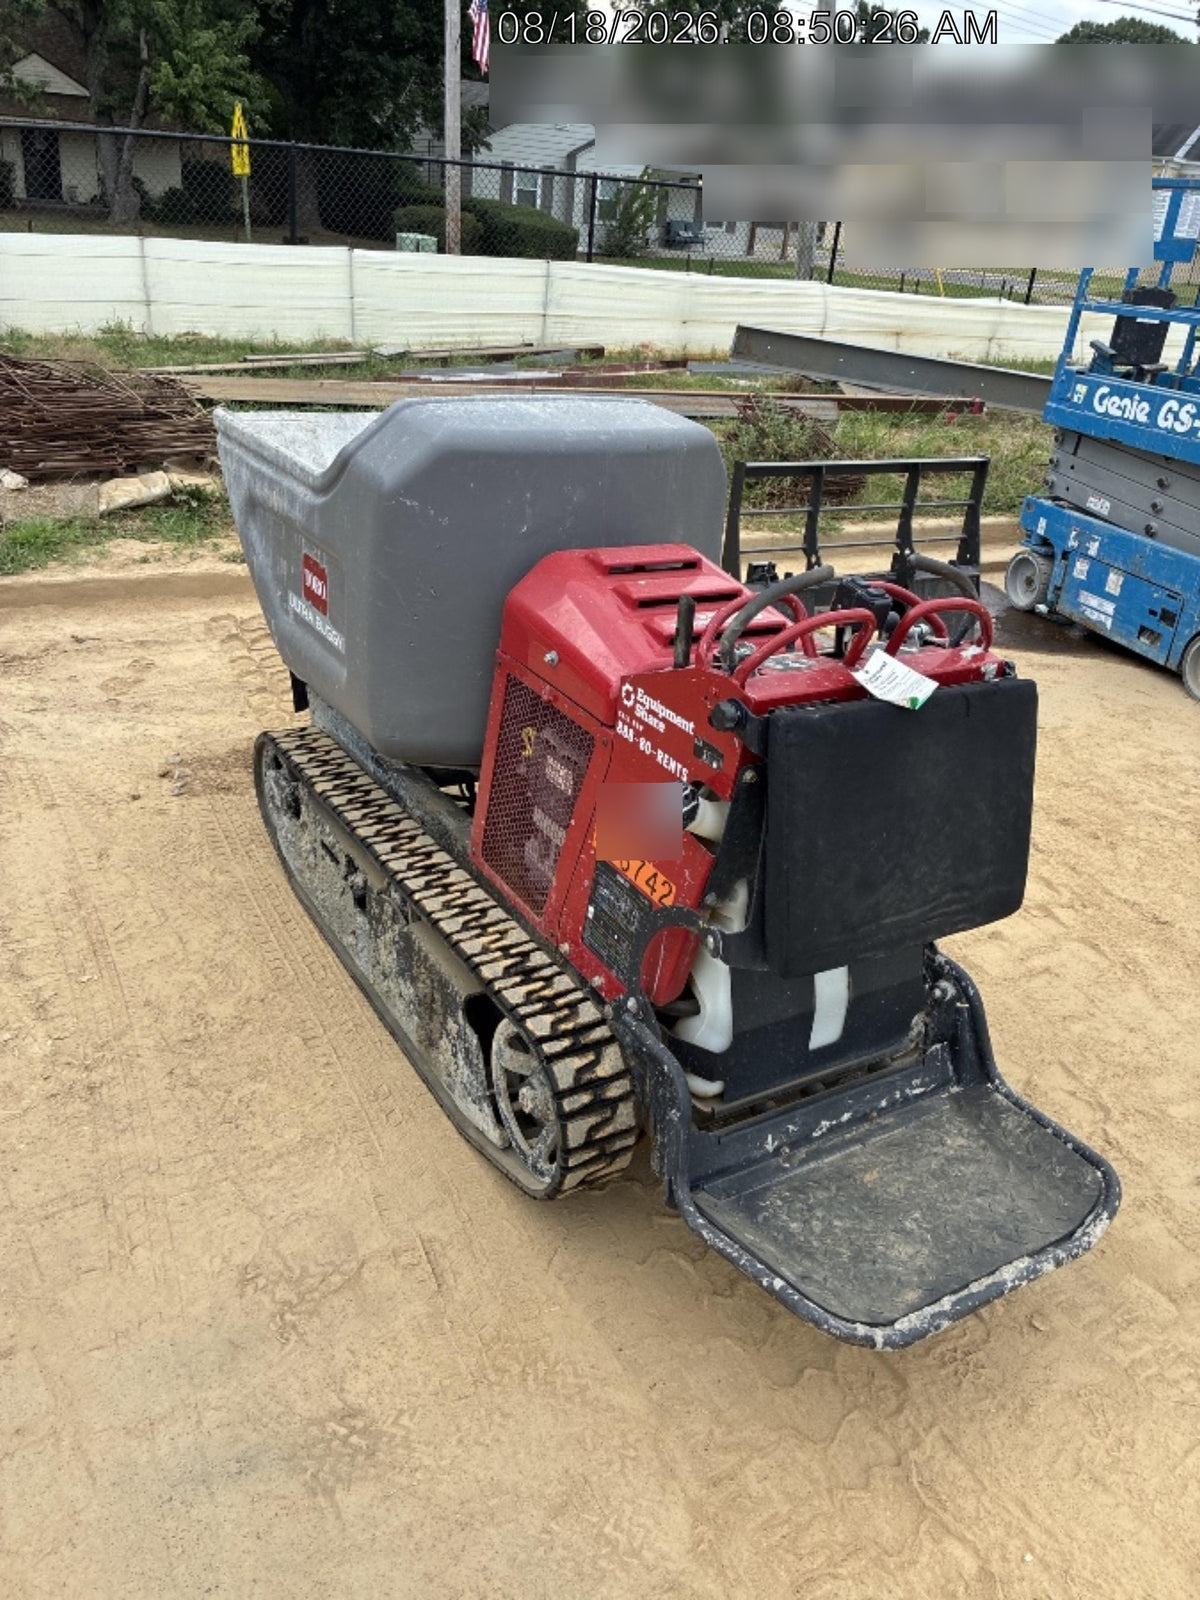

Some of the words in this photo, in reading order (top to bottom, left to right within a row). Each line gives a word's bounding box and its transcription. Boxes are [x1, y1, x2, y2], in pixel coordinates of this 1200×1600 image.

[1093, 386, 1151, 424] Genie
[1157, 400, 1200, 437] GS-
[634, 703, 666, 733] Share
[636, 687, 695, 736] Equipment
[616, 720, 689, 782] 888-80-RENTS
